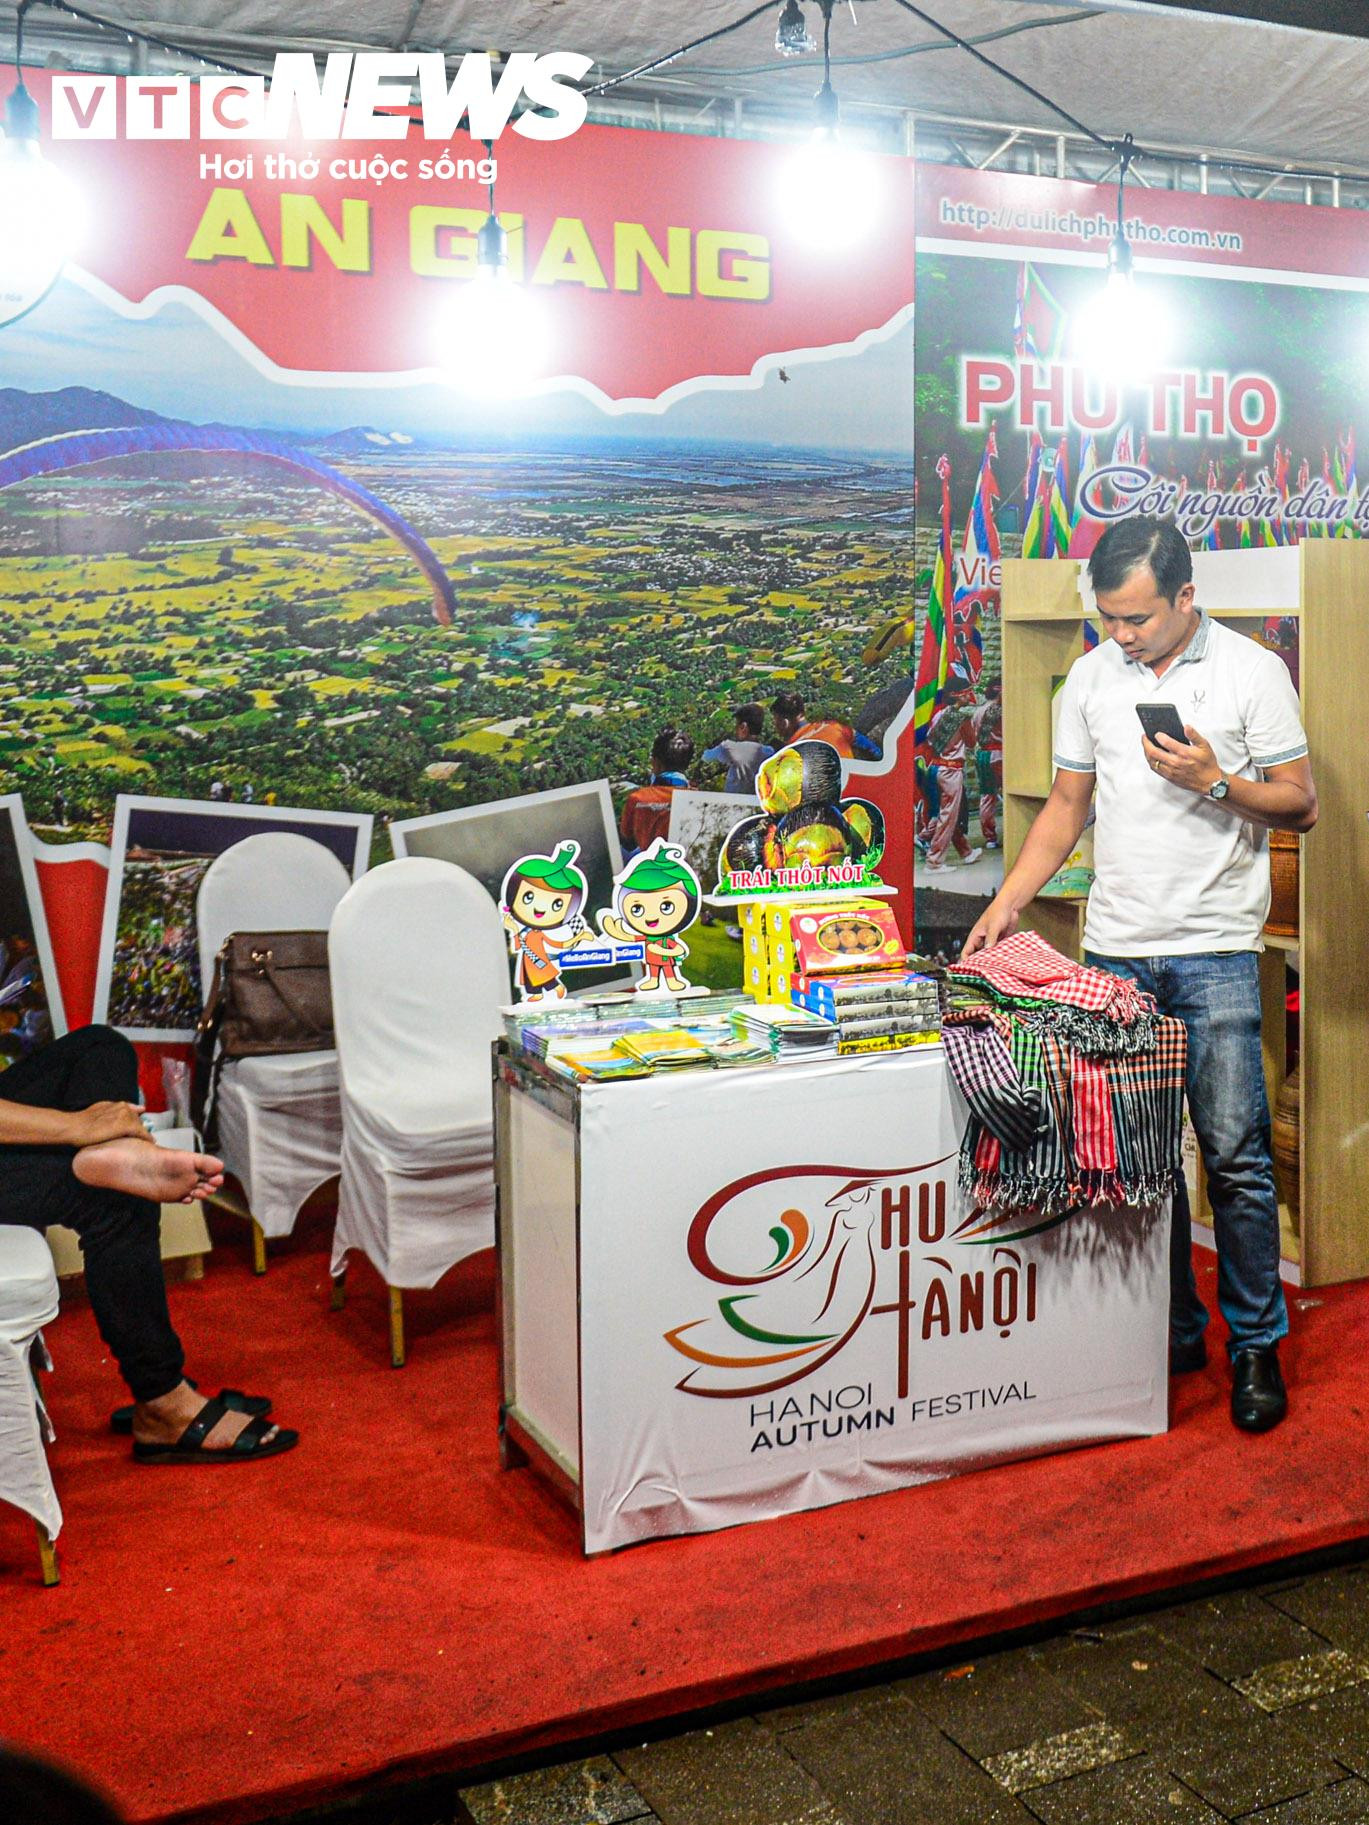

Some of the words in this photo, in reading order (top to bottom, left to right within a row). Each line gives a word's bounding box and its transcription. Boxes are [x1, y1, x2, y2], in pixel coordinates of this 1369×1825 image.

[185, 187, 372, 274] AN
[408, 204, 773, 303] GIANG
[1146, 372, 1278, 454] THỌ
[1178, 472, 1279, 537] nguồn
[1285, 480, 1347, 521] dân
[729, 865, 771, 889] TRÁI
[777, 861, 825, 886] THỐT
[827, 860, 866, 884] NỐT
[749, 1382, 873, 1427] HANOI
[750, 1406, 895, 1453] AUTUMN
[911, 1379, 1037, 1422] FESTIVAL
